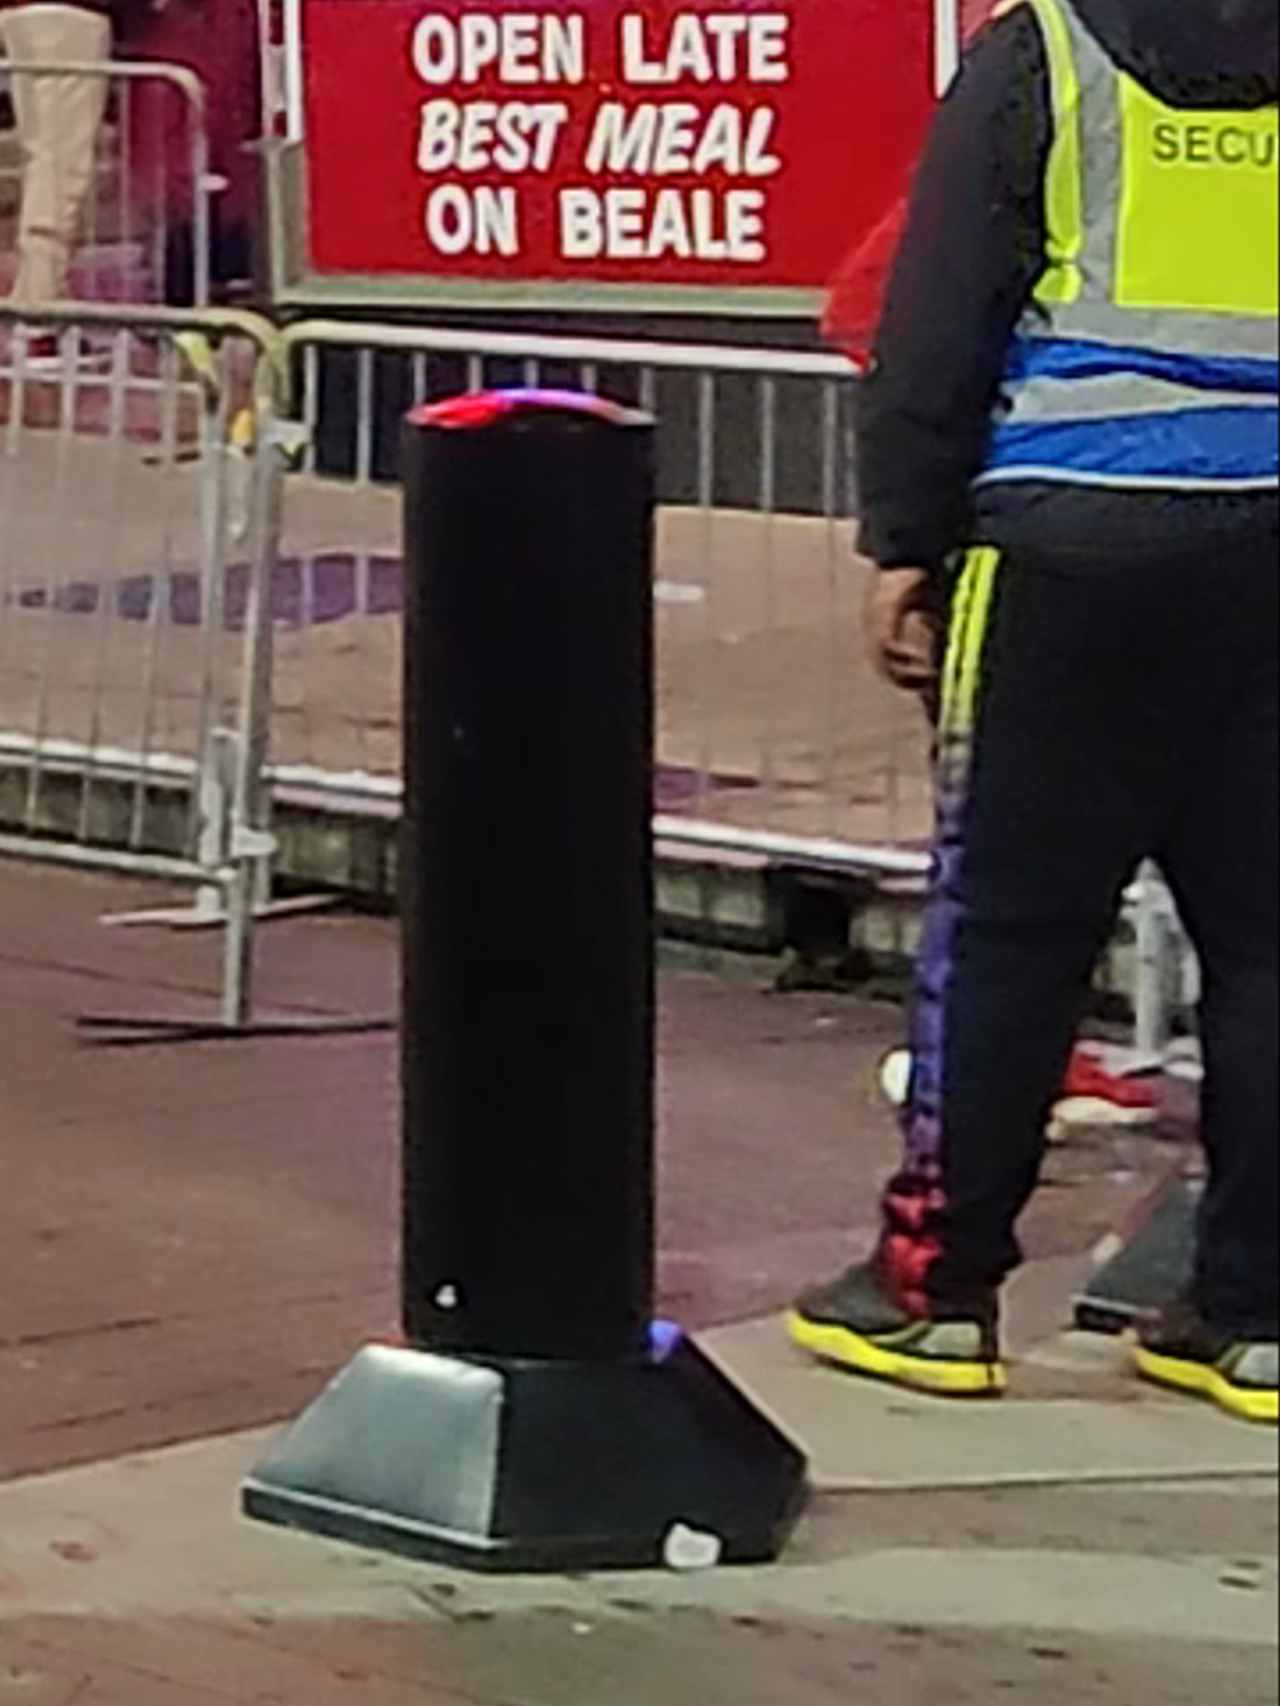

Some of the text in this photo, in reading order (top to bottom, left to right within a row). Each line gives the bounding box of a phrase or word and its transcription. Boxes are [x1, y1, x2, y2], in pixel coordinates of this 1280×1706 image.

[412, 13, 790, 84] OPEN LATE
[417, 98, 782, 177] BEST MEAL
[1153, 122, 1276, 167] SECU
[425, 184, 768, 263] ON BEALE
